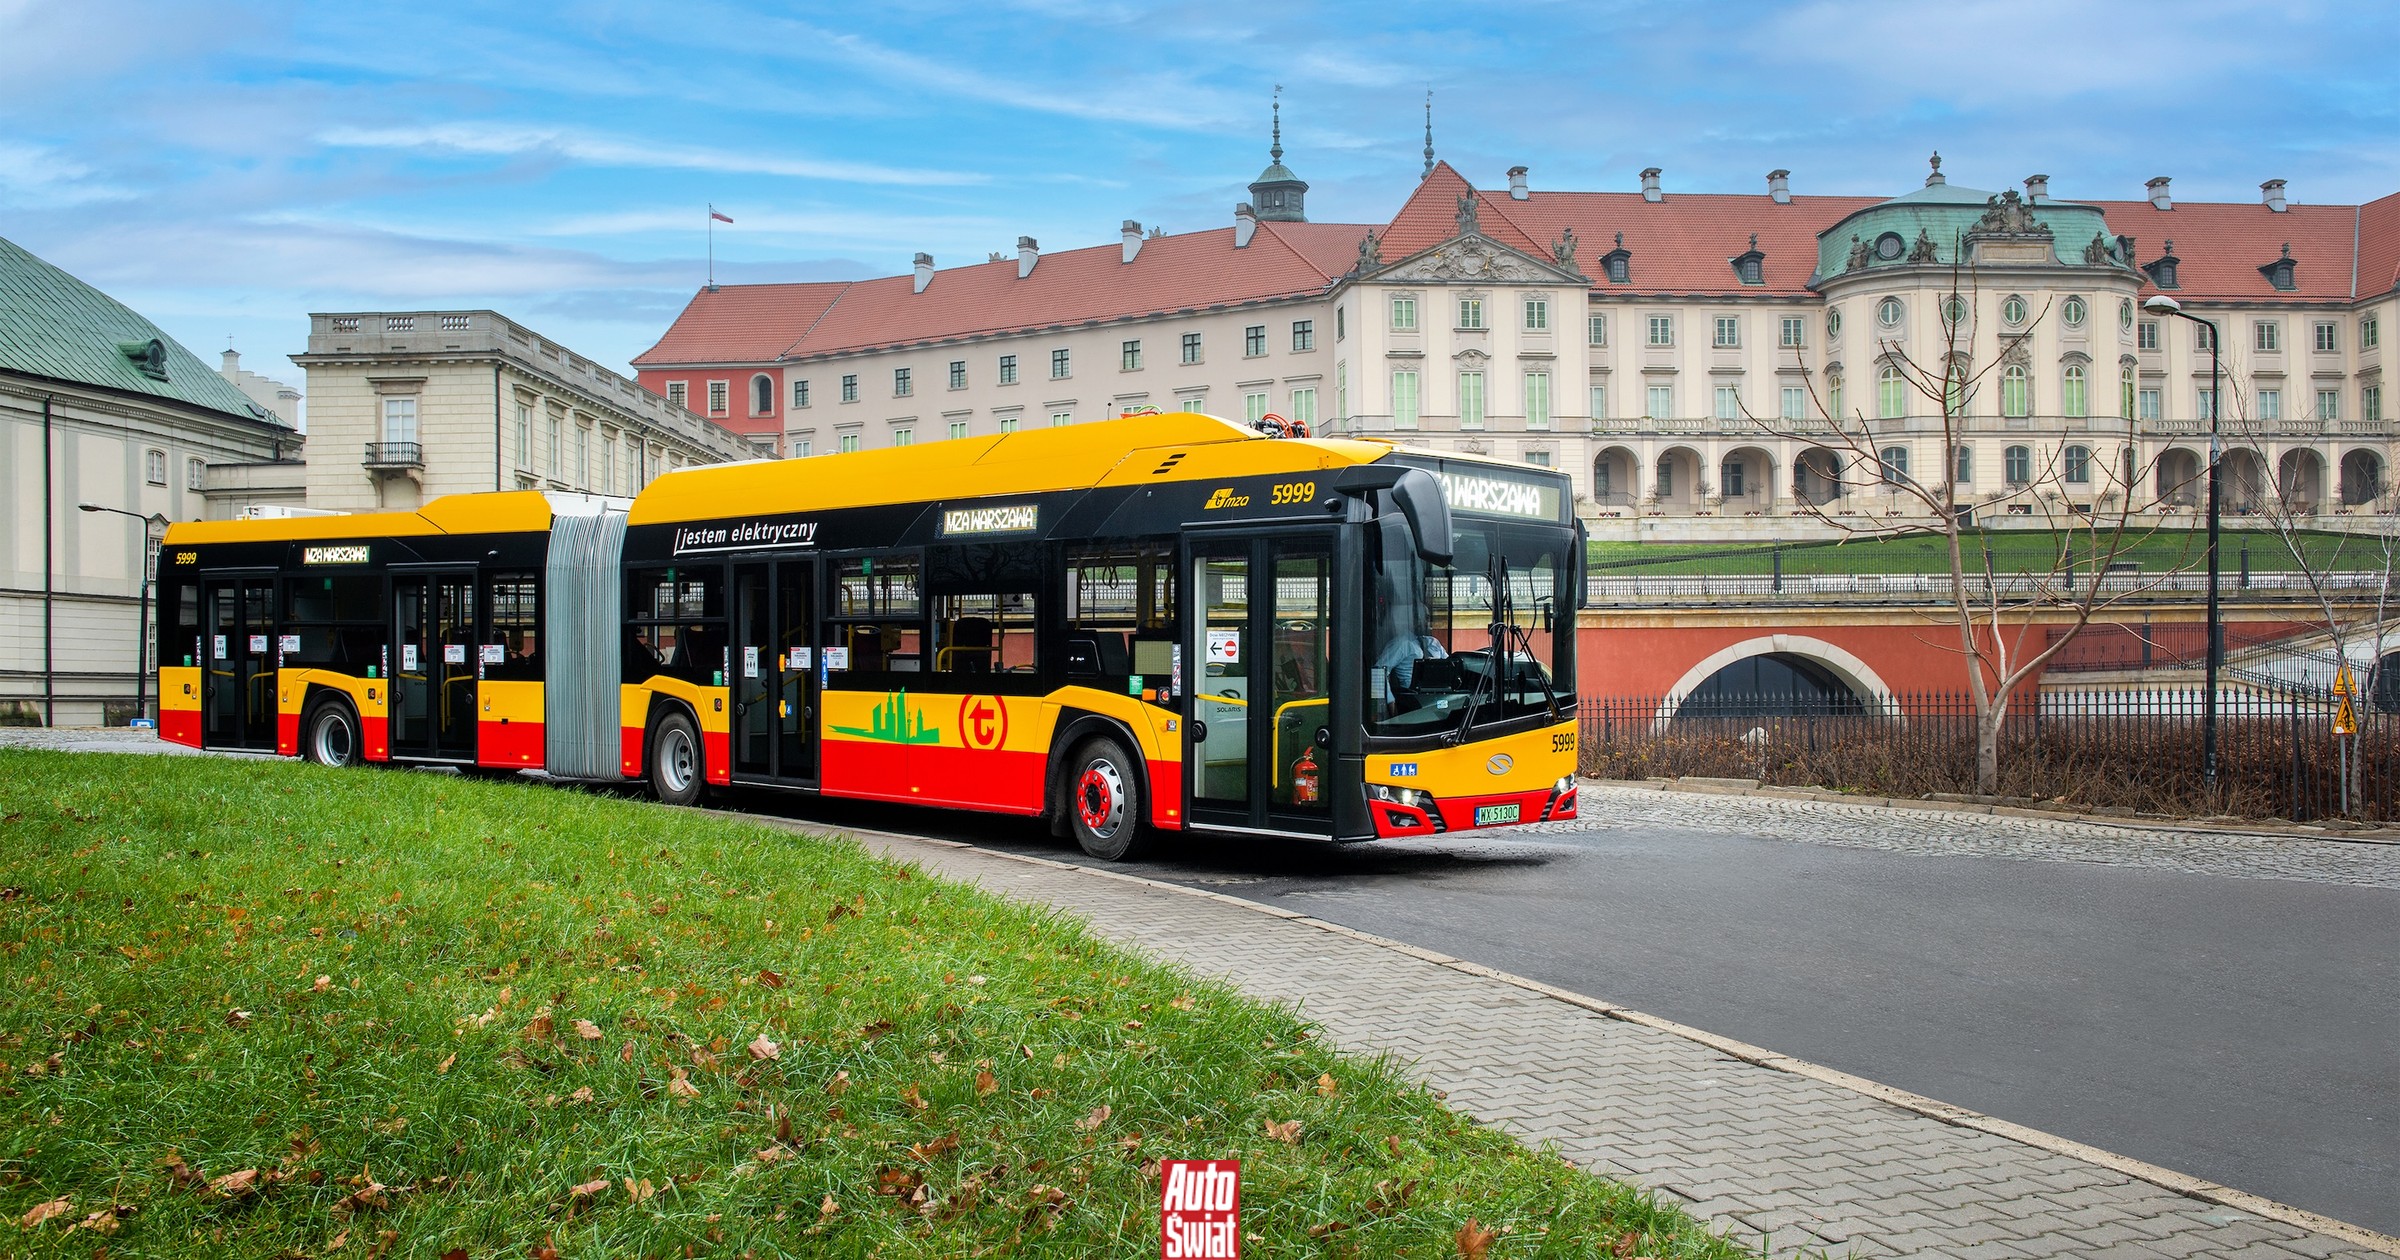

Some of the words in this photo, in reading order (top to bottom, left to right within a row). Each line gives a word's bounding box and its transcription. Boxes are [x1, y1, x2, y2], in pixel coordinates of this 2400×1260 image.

[1271, 481, 1316, 505] 5999
[1454, 476, 1540, 516] WARSZAWA
[946, 511, 970, 532] MZA
[970, 507, 1034, 531] WARSZAWA
[679, 528, 727, 550] jestem
[731, 522, 818, 544] elektryczny
[175, 552, 198, 565] 5999
[305, 548, 322, 563] MZA
[322, 546, 368, 562] WARSZAWA
[1552, 732, 1575, 753] 5999
[1480, 808, 1491, 822] WX
[1493, 806, 1518, 820] 5130C
